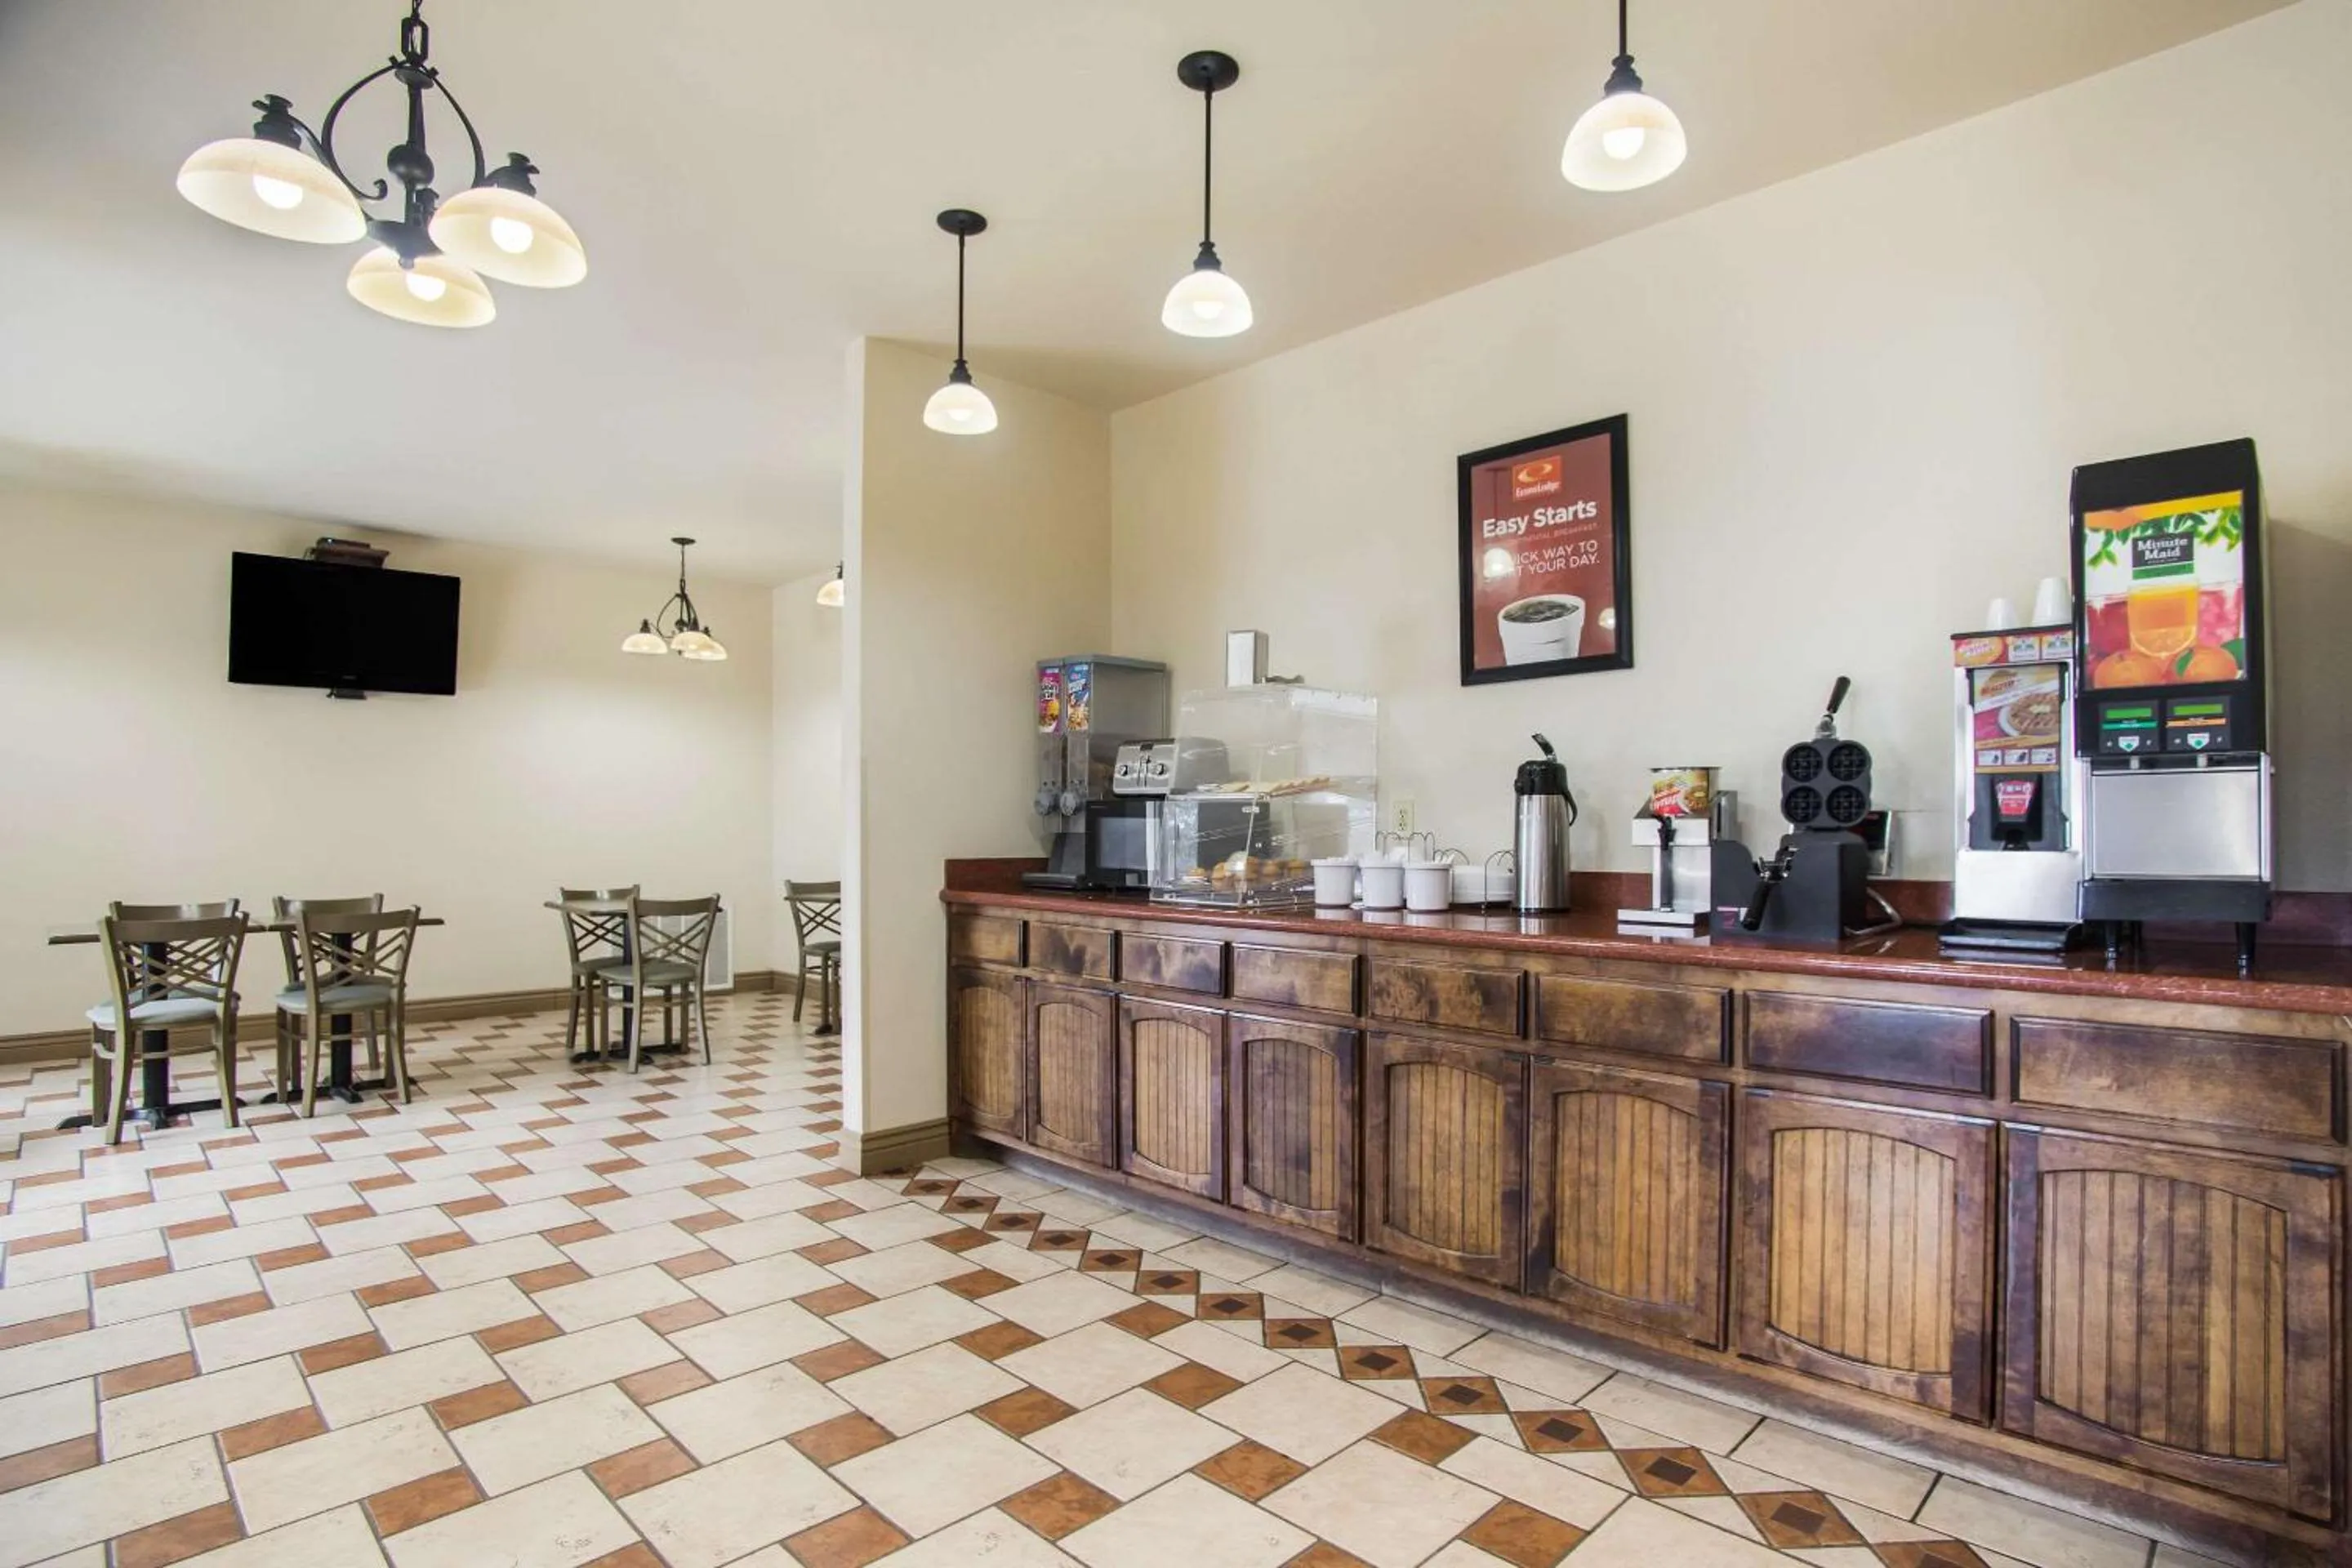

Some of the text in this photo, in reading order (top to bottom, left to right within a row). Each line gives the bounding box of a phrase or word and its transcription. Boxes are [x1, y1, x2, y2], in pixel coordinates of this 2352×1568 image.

[1482, 515, 1529, 539] Easy
[1533, 500, 1597, 528] Starts
[1542, 544, 1574, 560] WAY
[1578, 540, 1598, 555] TO
[2137, 538, 2188, 551] Minute
[2145, 546, 2180, 560] Maid
[1528, 559, 1566, 575] YOUR
[1569, 553, 1601, 568] DAY.
